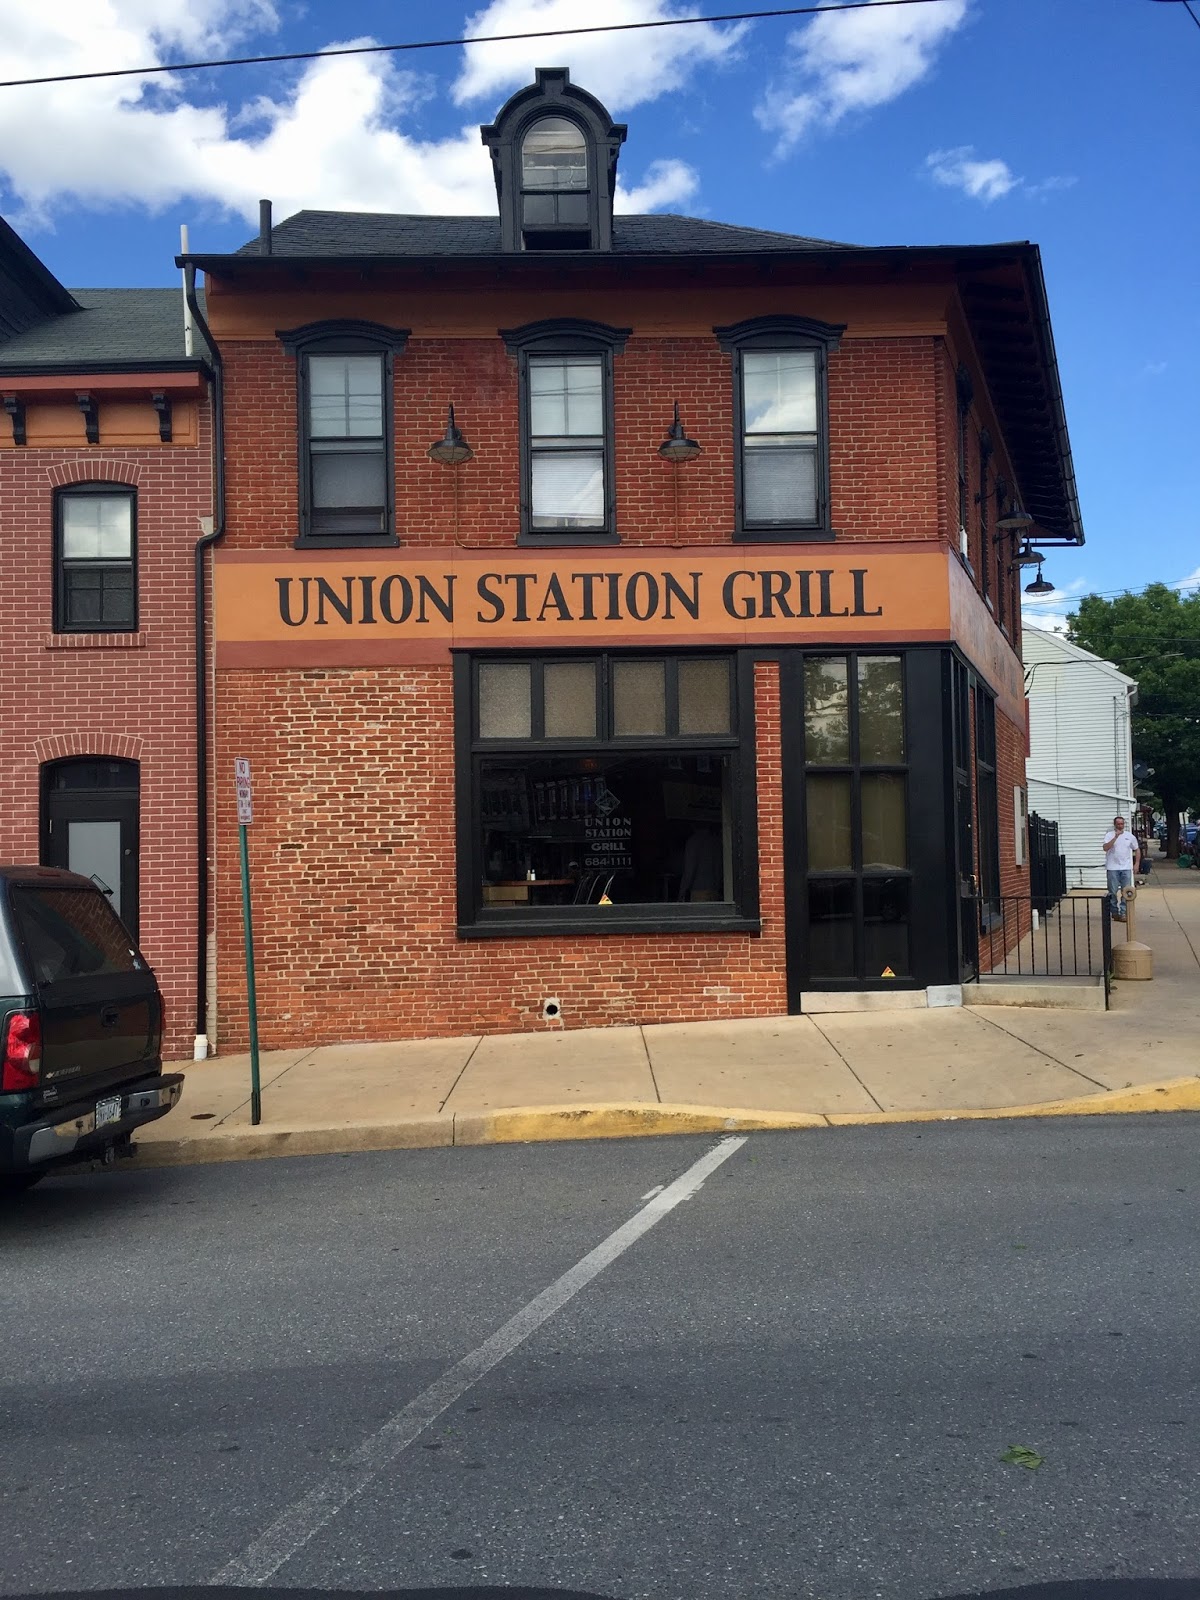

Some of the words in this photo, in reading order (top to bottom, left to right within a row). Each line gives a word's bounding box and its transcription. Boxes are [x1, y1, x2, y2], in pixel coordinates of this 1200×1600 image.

[275, 575, 457, 626] UNION
[477, 572, 702, 622] STATION
[723, 570, 882, 619] GRILL
[585, 817, 631, 827] UNION
[585, 828, 631, 837] STATION
[591, 842, 626, 851] GRILL
